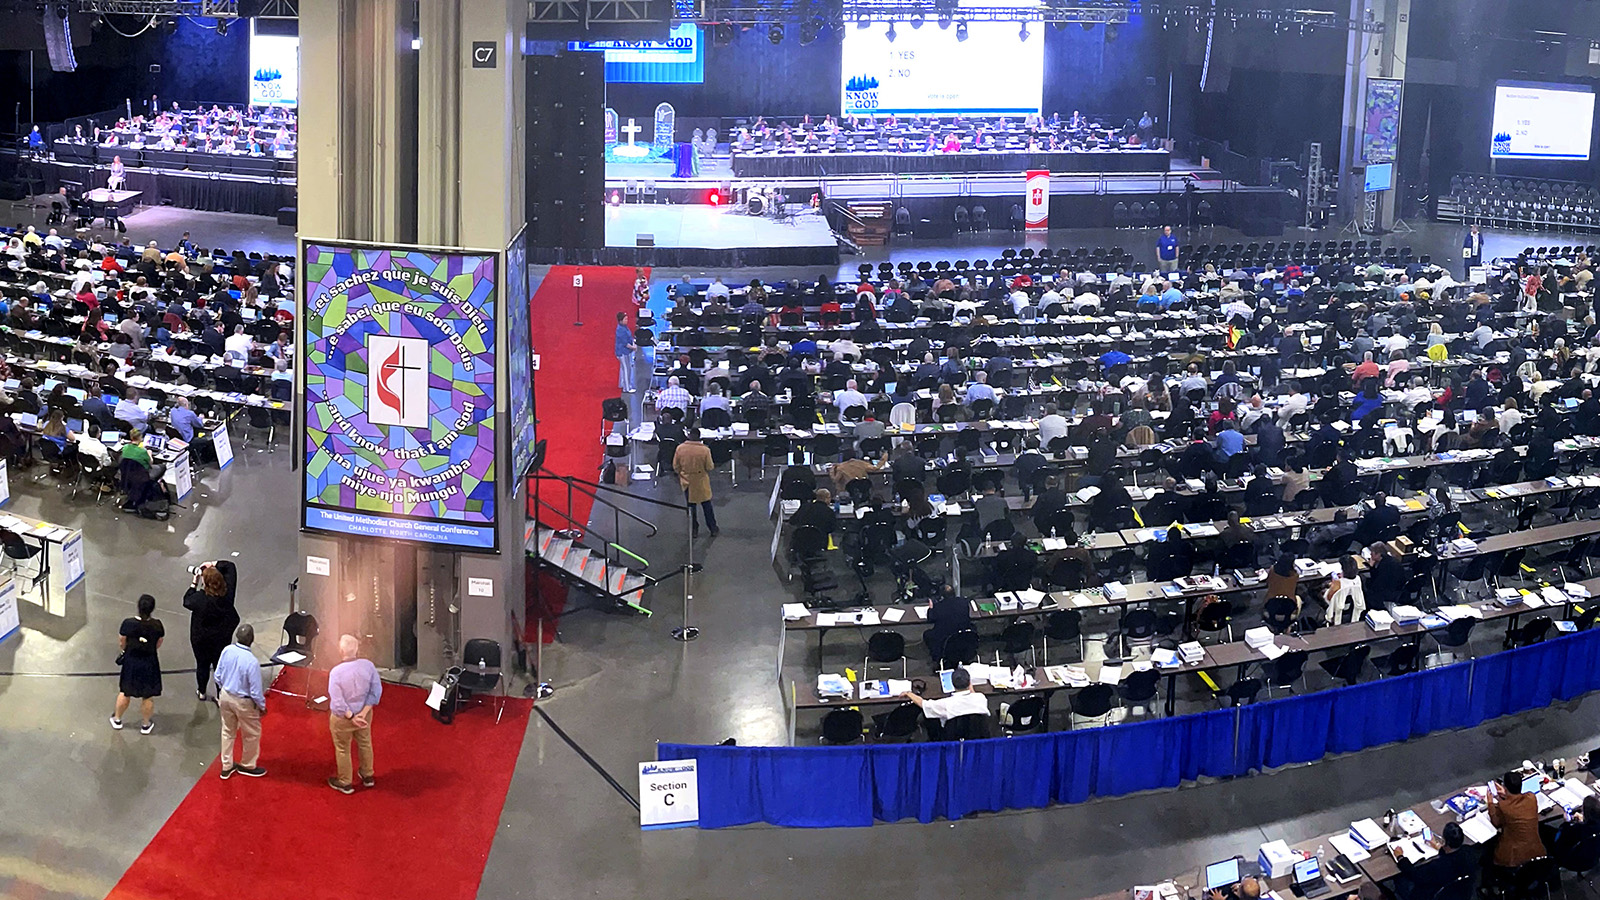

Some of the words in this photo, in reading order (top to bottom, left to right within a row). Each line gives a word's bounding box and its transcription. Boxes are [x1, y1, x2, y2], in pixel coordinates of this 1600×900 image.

[666, 37, 693, 48] GOD
[475, 47, 494, 62] C7
[898, 50, 915, 60] YES
[898, 68, 911, 78] NO
[845, 91, 879, 100] KNOW
[855, 99, 879, 109] GOD
[575, 277, 581, 286] 3
[328, 269, 380, 298] sachez
[382, 269, 411, 282] que
[411, 271, 428, 287] je
[429, 281, 462, 305] suis
[460, 300, 489, 335] Dieu
[335, 304, 371, 336] sabei
[372, 301, 400, 315] que
[404, 304, 424, 317] eu
[424, 310, 453, 335] sou
[449, 333, 475, 372] Deus
[348, 429, 388, 456] know
[394, 447, 427, 460] that
[426, 443, 437, 454] I
[437, 431, 459, 450] am
[453, 400, 475, 432] God
[353, 464, 386, 486] ujue
[388, 476, 407, 489] ya
[409, 458, 472, 488] kwamba
[341, 474, 377, 498] miye
[379, 490, 404, 505] njo
[407, 484, 458, 503] Mungu
[320, 510, 333, 519] The
[333, 512, 355, 523] United
[355, 515, 388, 527] Methodist
[388, 520, 412, 529] Church
[413, 521, 440, 532] General
[440, 525, 479, 536] Conference
[414, 531, 449, 540] CAROLINA
[650, 781, 688, 792] Section
[664, 793, 675, 806] C
